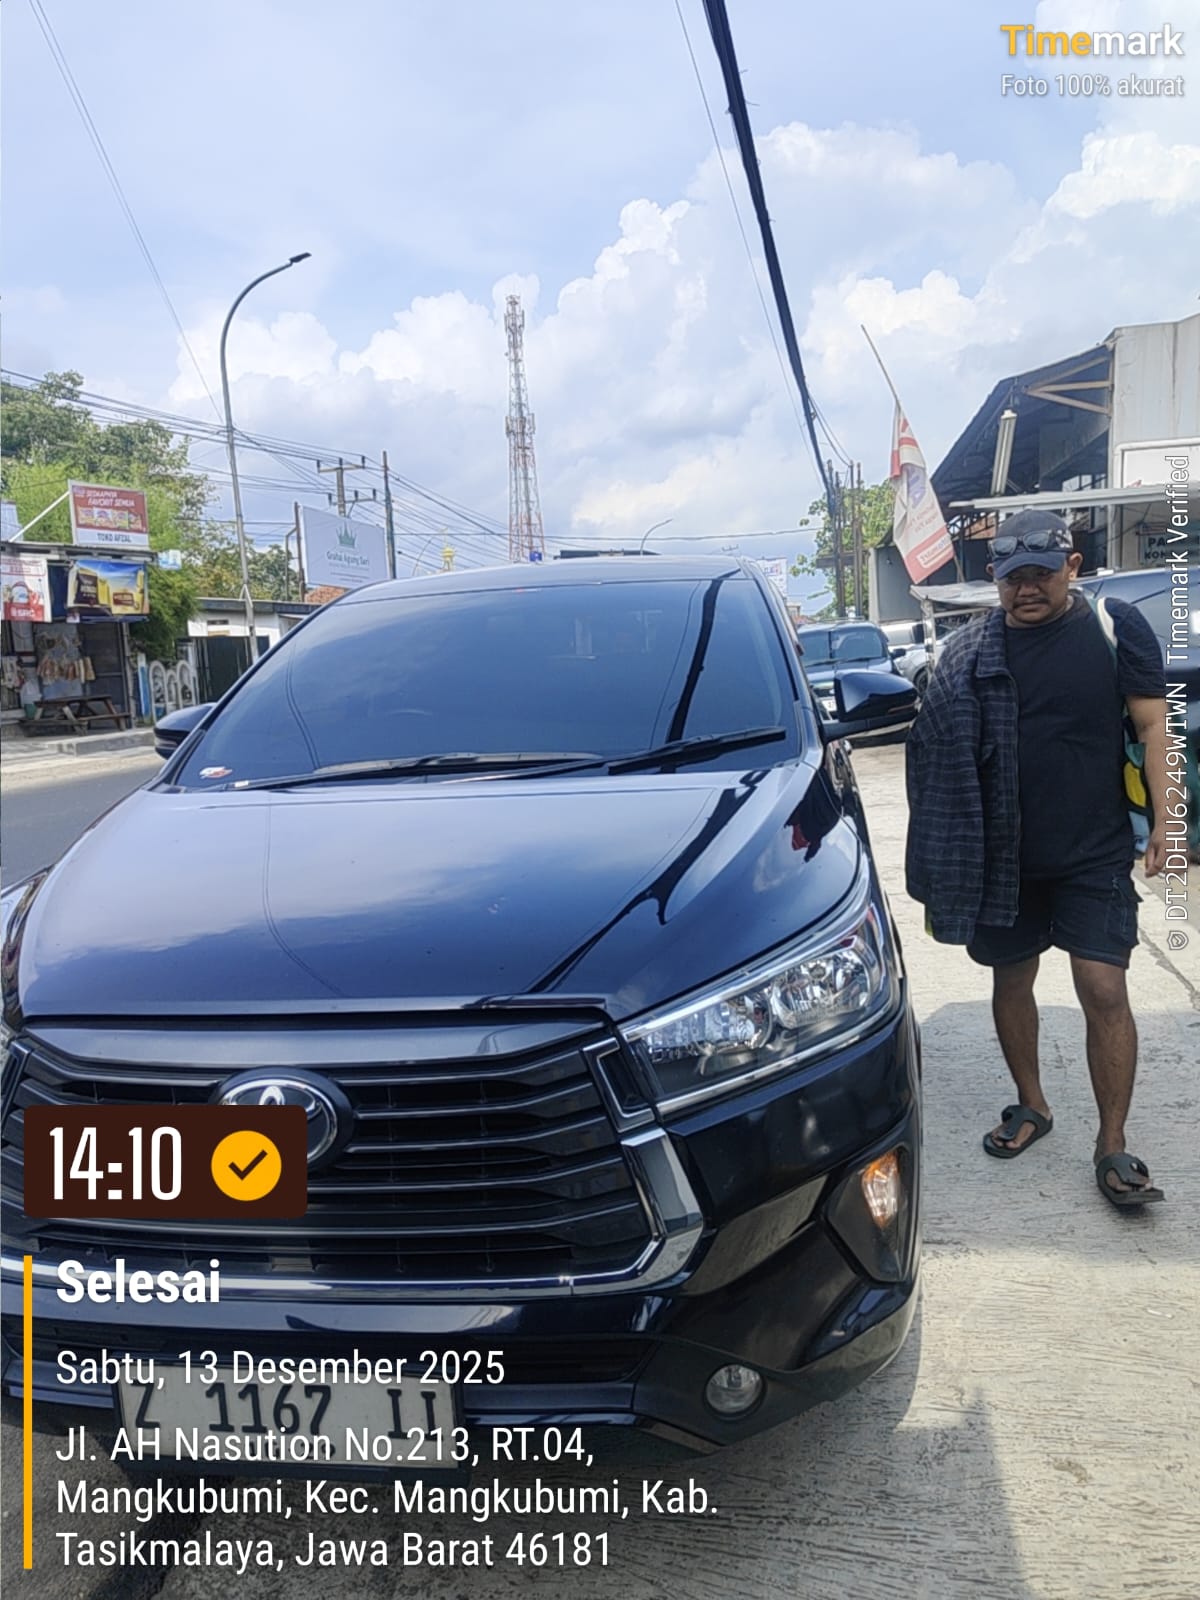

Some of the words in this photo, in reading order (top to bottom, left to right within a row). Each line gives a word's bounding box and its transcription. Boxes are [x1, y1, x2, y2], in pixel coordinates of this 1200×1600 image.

[131, 1379, 161, 1429] Z
[205, 1381, 331, 1436] 1167
[387, 1388, 443, 1442] II
